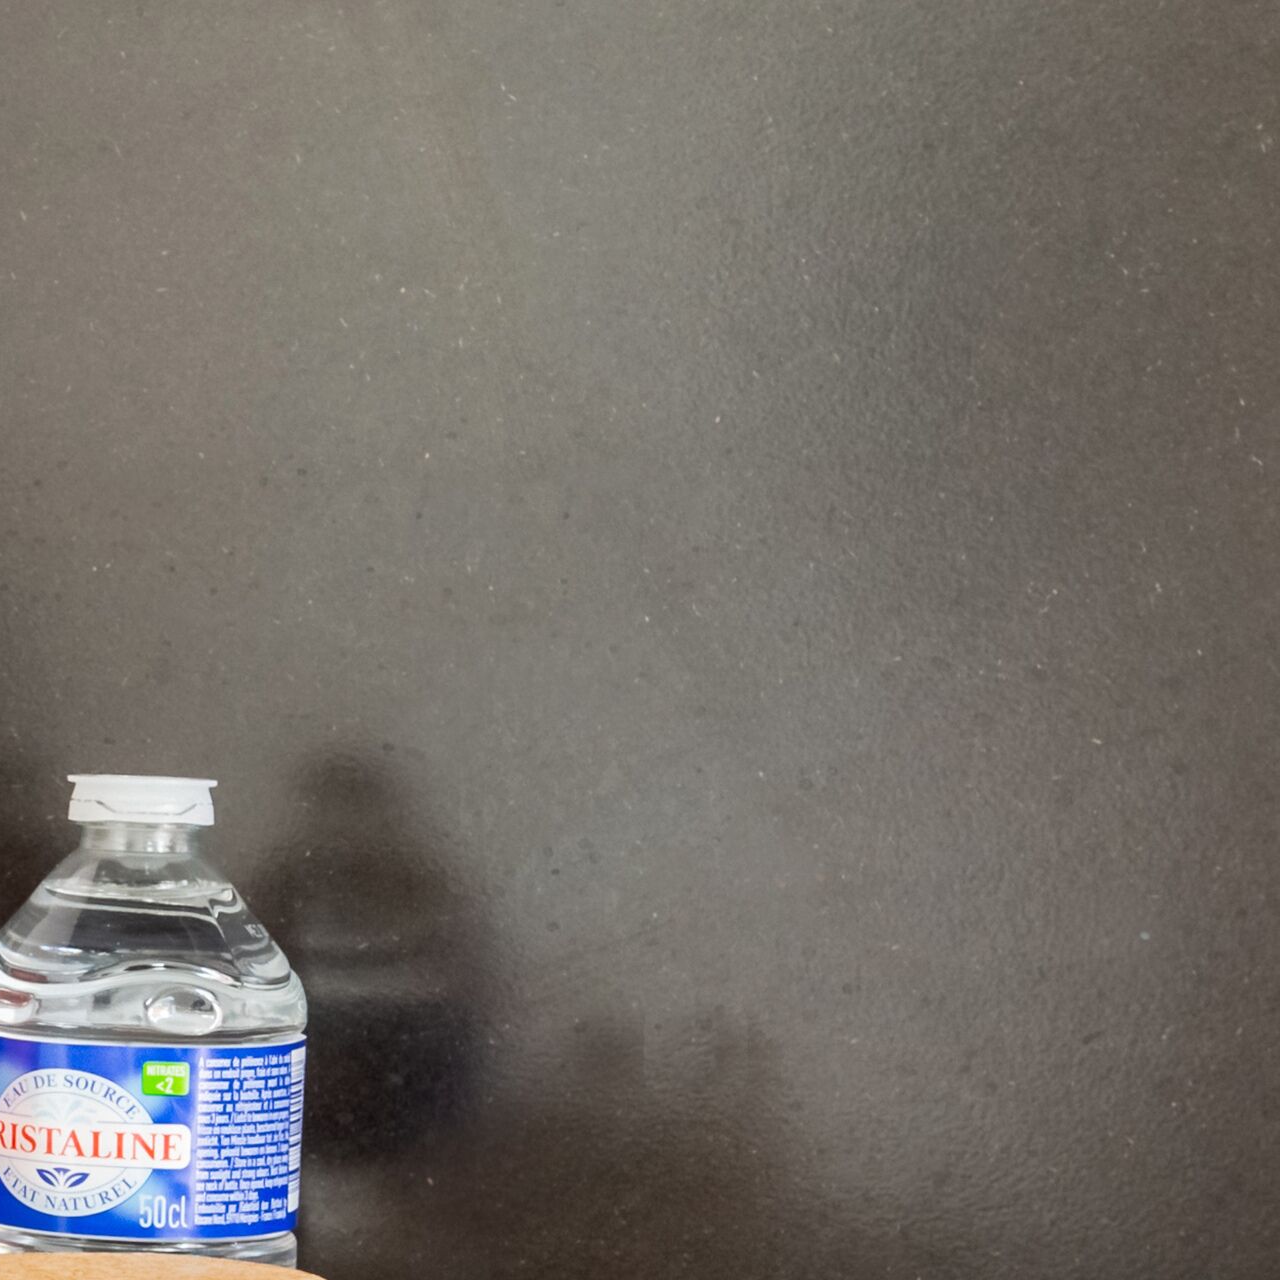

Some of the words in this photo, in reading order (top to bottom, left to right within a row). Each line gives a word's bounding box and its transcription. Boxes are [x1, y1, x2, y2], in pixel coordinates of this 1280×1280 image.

[2, 1083, 29, 1108] EAU
[34, 1075, 56, 1088] DE
[63, 1075, 140, 1120] SOURCE
[45, 1177, 138, 1211] NATUREL
[140, 1195, 188, 1228] 50cl
